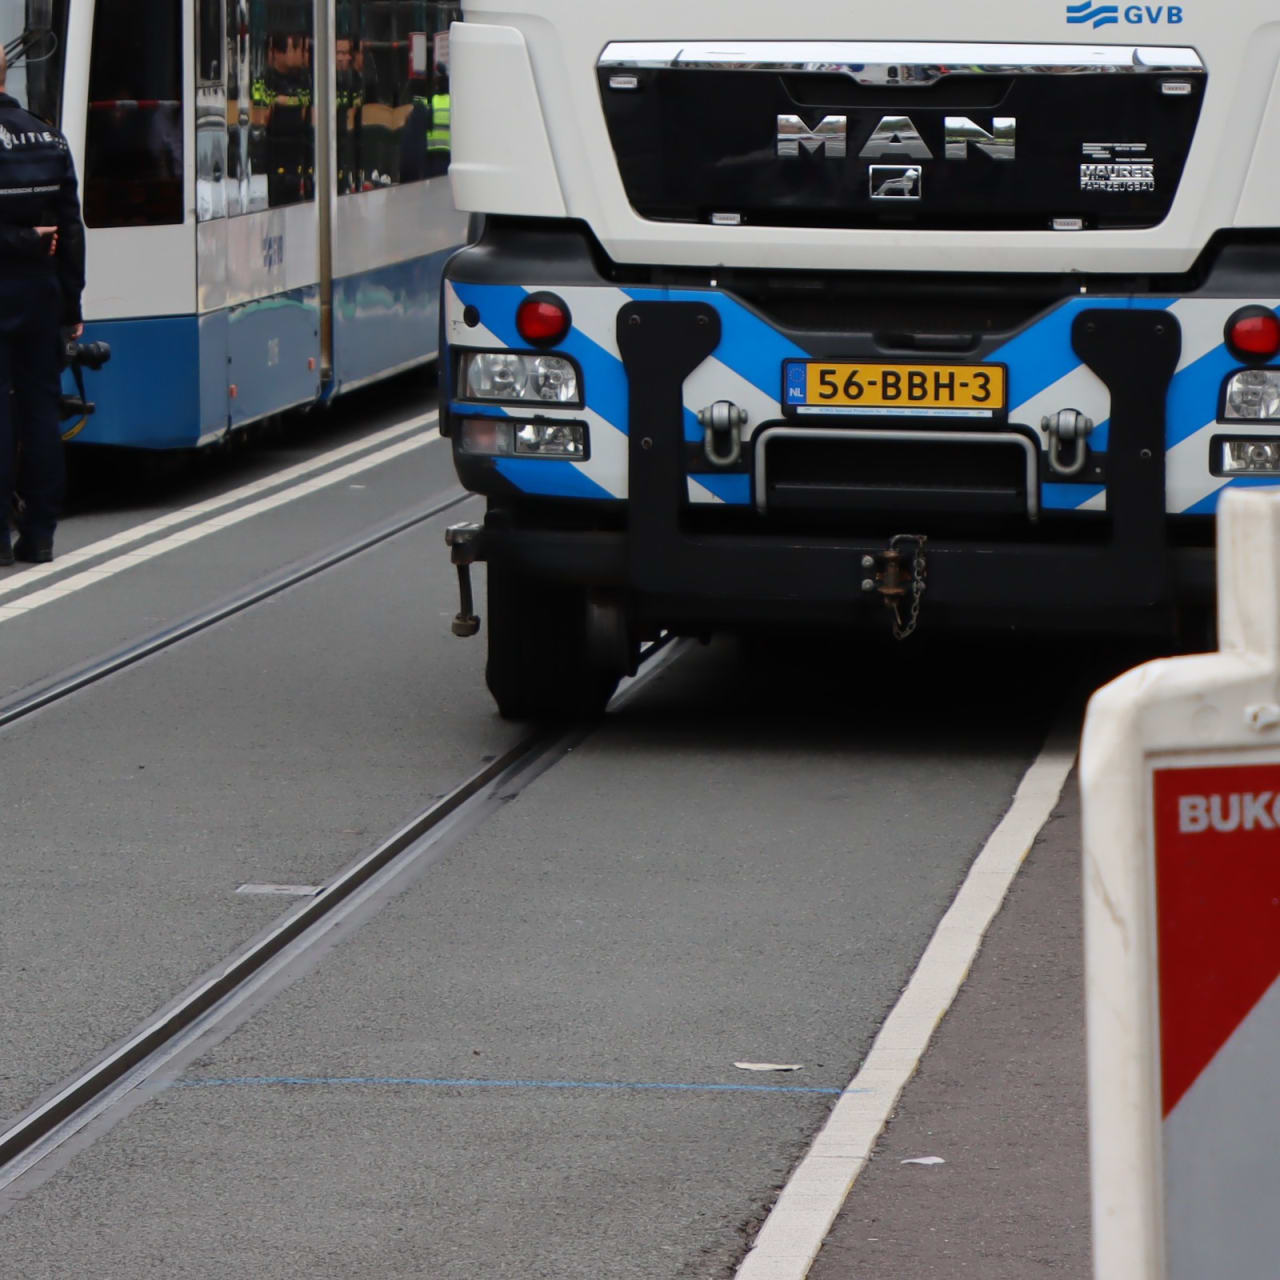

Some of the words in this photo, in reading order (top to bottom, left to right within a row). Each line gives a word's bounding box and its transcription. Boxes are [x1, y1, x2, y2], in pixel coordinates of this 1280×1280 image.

[1124, 6, 1184, 24] GVB
[777, 114, 1016, 159] MAN
[1080, 164, 1154, 178] MAURER
[1080, 180, 1154, 191] FAHRZEUGBAU
[790, 387, 804, 398] NL
[819, 369, 991, 402] 56-BBH-3
[1179, 791, 1280, 833] BUK
